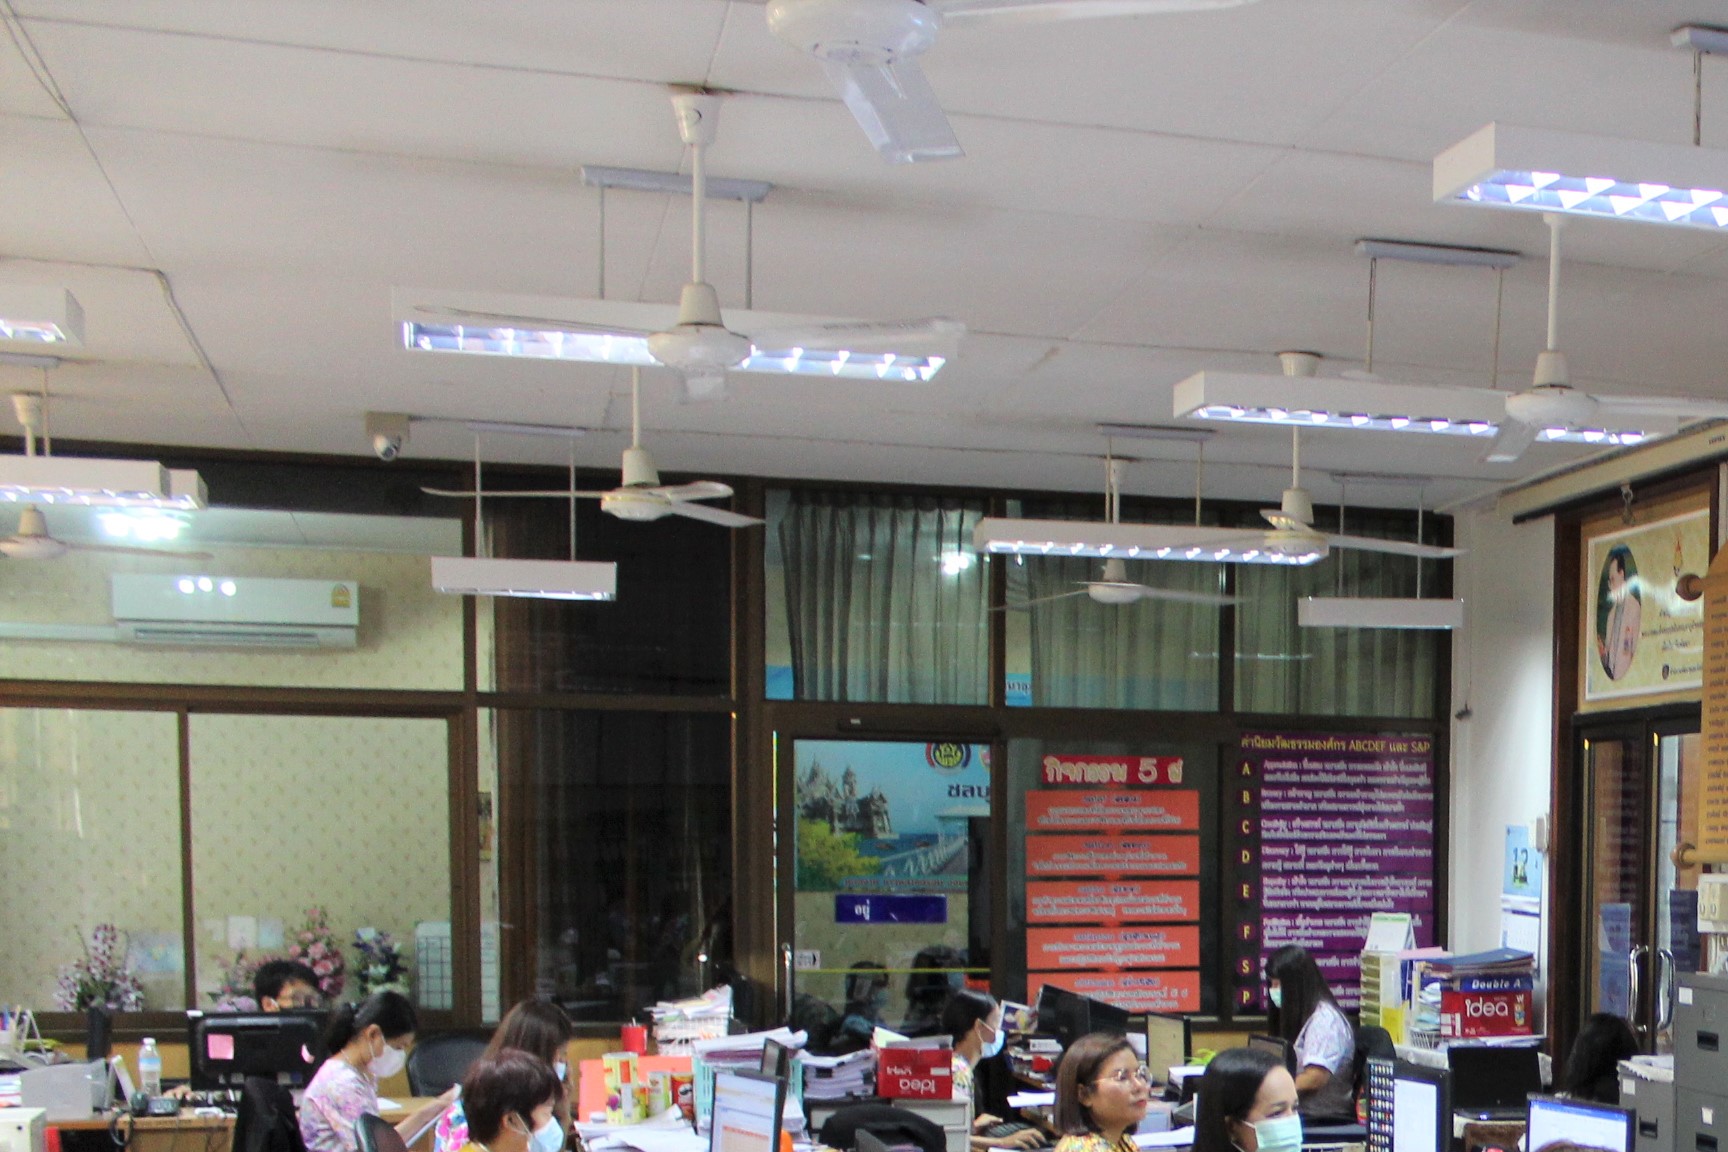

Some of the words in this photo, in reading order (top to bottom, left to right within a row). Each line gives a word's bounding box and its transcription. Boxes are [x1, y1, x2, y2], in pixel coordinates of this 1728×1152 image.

[1349, 739, 1386, 752] ABCDEF
[1411, 739, 1431, 753] S&P
[1138, 757, 1157, 783] 5
[1241, 763, 1250, 776] A
[1243, 790, 1250, 804] B
[1242, 820, 1249, 834] C
[1242, 850, 1250, 863] D
[1242, 885, 1249, 898] E
[1243, 926, 1250, 940] F
[1242, 960, 1249, 973] S
[1472, 979, 1510, 990] Double
[1513, 978, 1521, 989] A
[1242, 990, 1249, 1004] P
[1465, 996, 1508, 1018] idea
